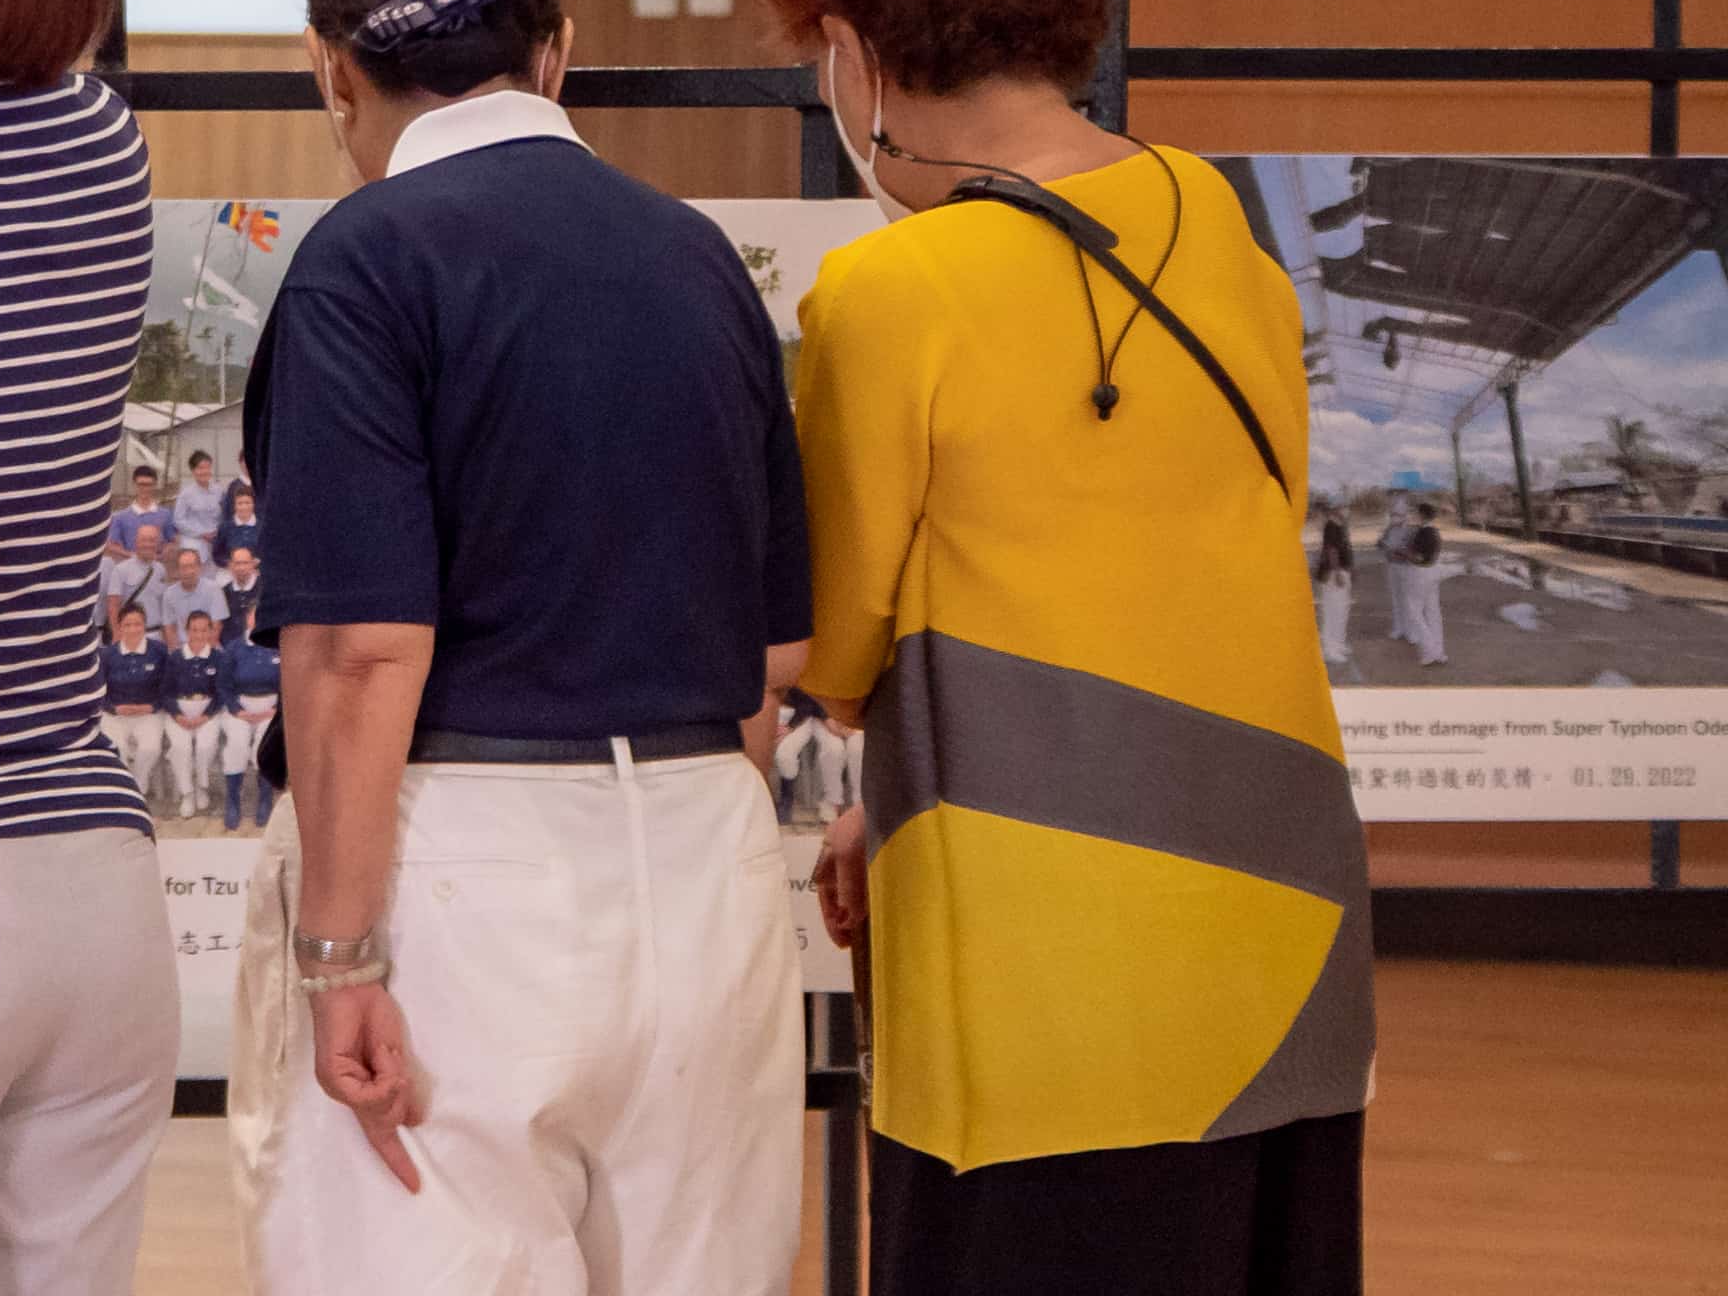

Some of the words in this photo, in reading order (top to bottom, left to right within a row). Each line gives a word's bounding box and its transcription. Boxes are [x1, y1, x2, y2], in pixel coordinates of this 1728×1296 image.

[1392, 719, 1425, 737] the
[1427, 719, 1500, 741] damage
[1502, 720, 1548, 737] from
[1551, 719, 1605, 739] Super
[1607, 718, 1689, 739] Typhoon
[164, 877, 196, 895] for
[201, 877, 239, 895] Tzu
[177, 930, 242, 955] 志工
